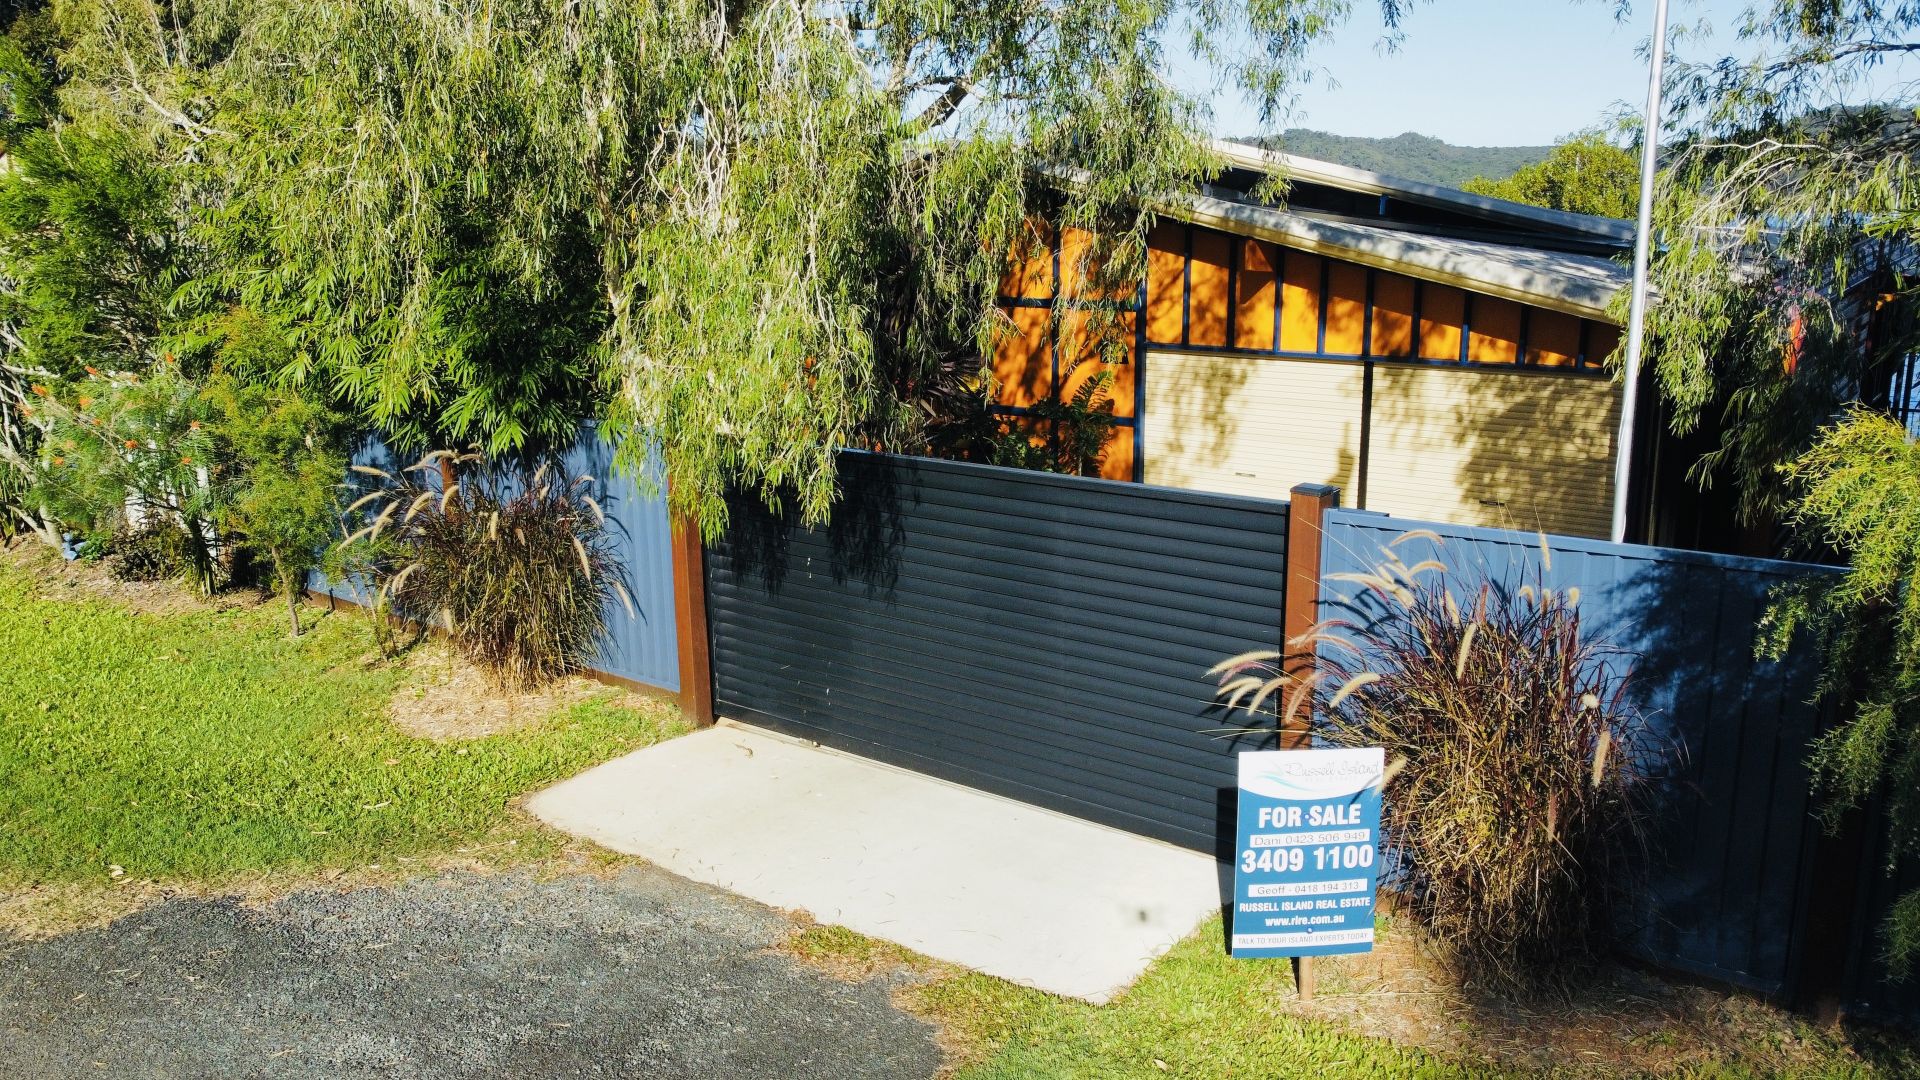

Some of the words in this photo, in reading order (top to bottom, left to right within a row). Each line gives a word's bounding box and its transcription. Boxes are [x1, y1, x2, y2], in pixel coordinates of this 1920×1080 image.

[1258, 806, 1302, 829] FOR
[1308, 803, 1362, 827] SALE
[1285, 834, 1314, 845] 0423
[1345, 831, 1365, 841] 949
[1241, 847, 1304, 873] 3409
[1313, 844, 1374, 870] 1100
[1257, 886, 1285, 896] Geoff
[1294, 883, 1318, 893] 0418
[1322, 882, 1338, 891] 194
[1342, 880, 1359, 890] 313
[1239, 902, 1279, 912] RUSSELL
[1281, 900, 1313, 911] ISLAND
[1315, 899, 1338, 909] REAL
[1340, 896, 1371, 907] ESTATE
[1265, 914, 1345, 926] www.rire.com.au
[1238, 937, 1254, 945] TALK
[1268, 936, 1287, 944] YOUR
[1288, 935, 1313, 943] ISLAND
[1315, 933, 1345, 942] EXPERTS
[1347, 932, 1368, 940] TODAY
